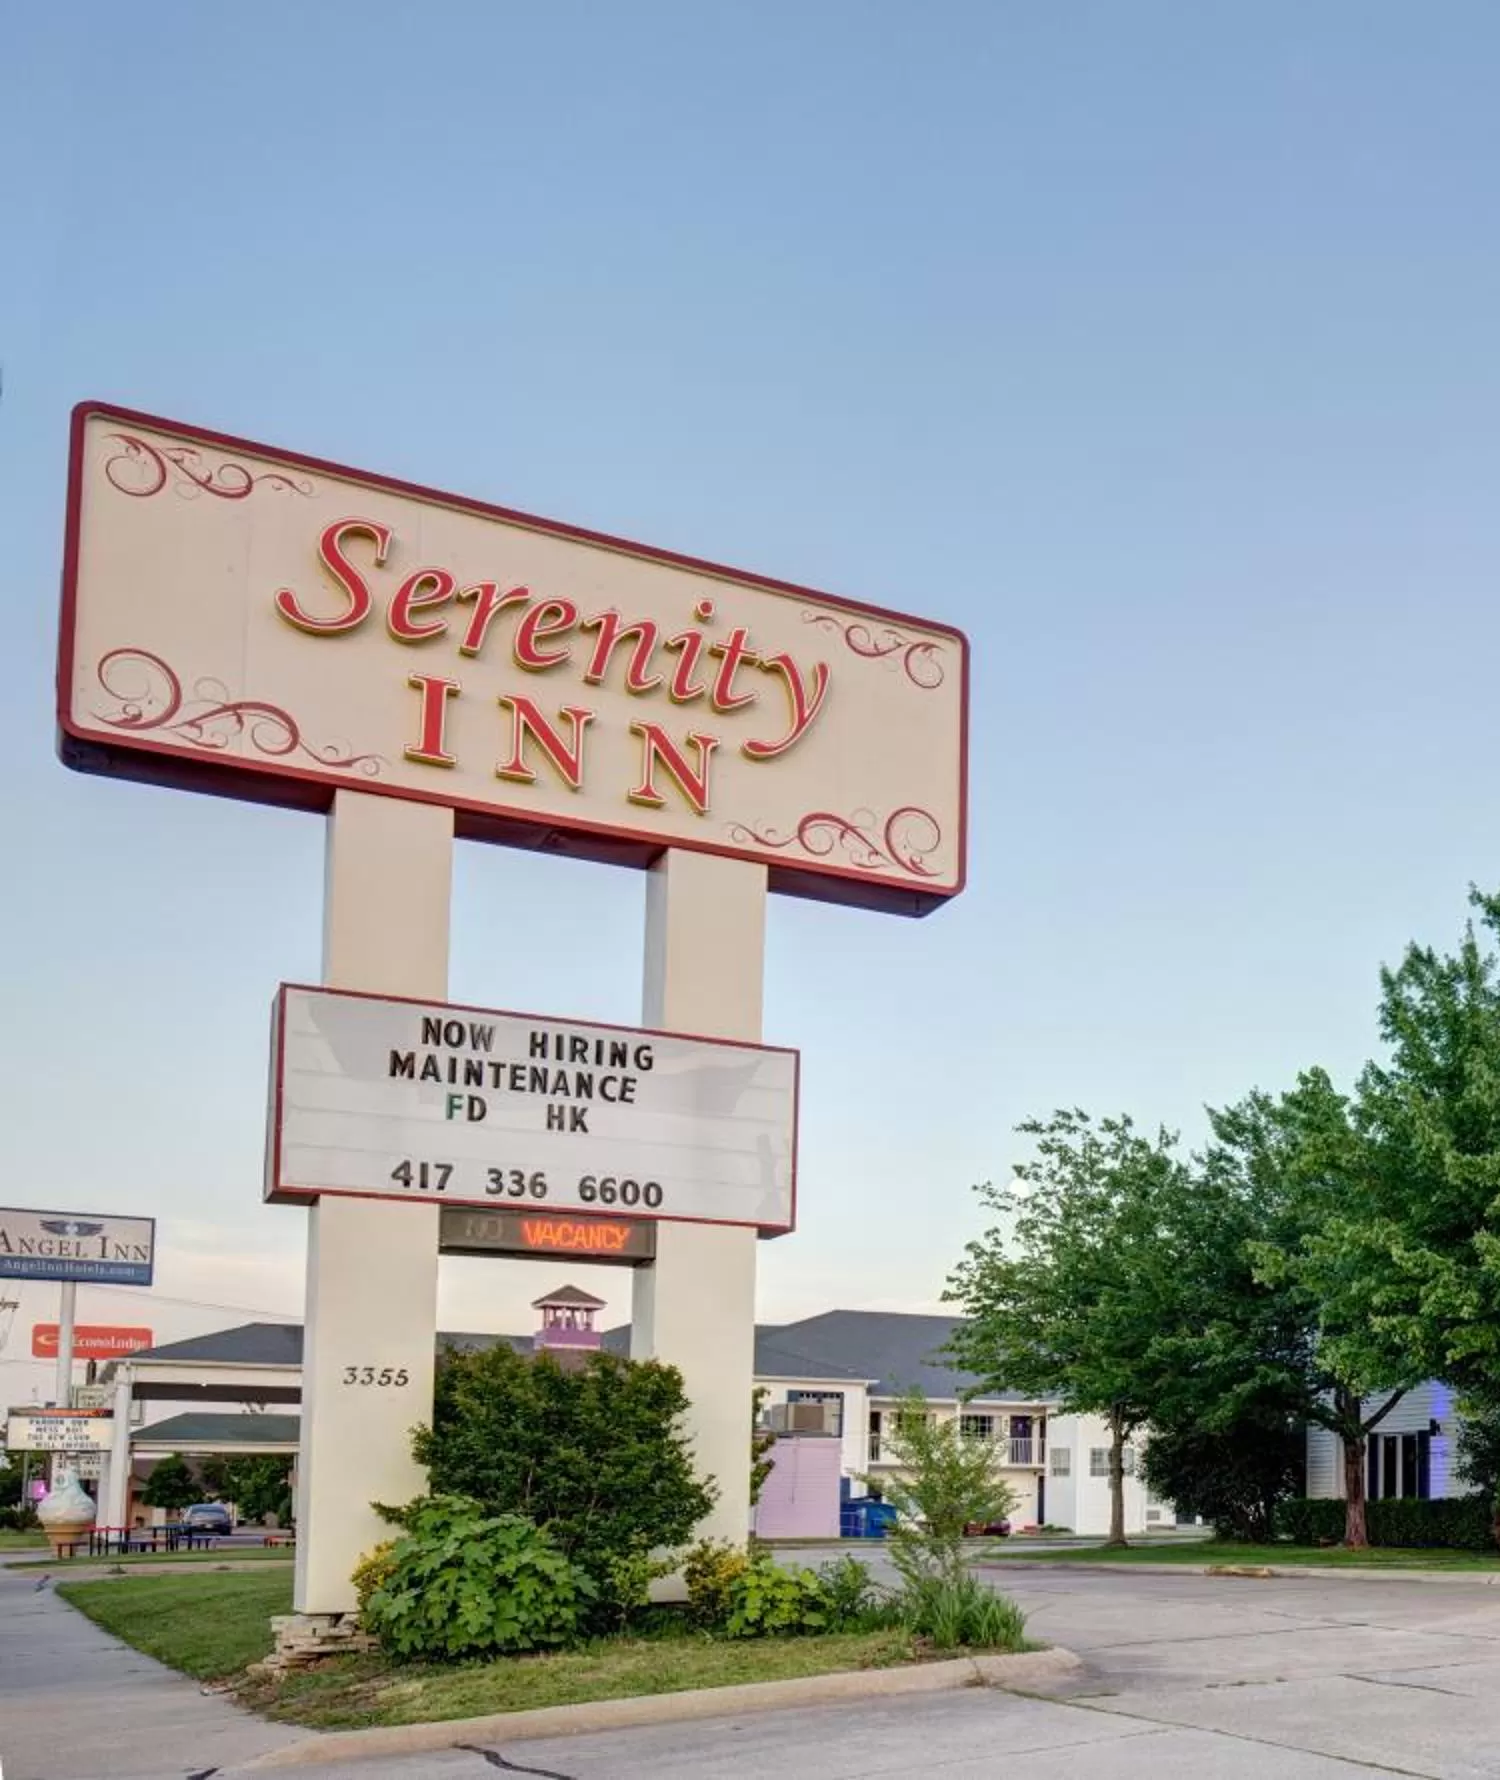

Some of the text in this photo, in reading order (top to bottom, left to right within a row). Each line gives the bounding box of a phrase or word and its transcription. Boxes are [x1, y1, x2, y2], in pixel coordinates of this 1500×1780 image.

[275, 517, 832, 761] Serenity
[404, 673, 721, 817] INN
[421, 1016, 655, 1072] NOW HIRING
[388, 1050, 638, 1103] MAINTENANCE
[445, 1094, 590, 1134] FD HK
[390, 1160, 664, 1208] 417 336 6600
[521, 1220, 632, 1251] VACANCY
[342, 1367, 410, 1387] 3355
